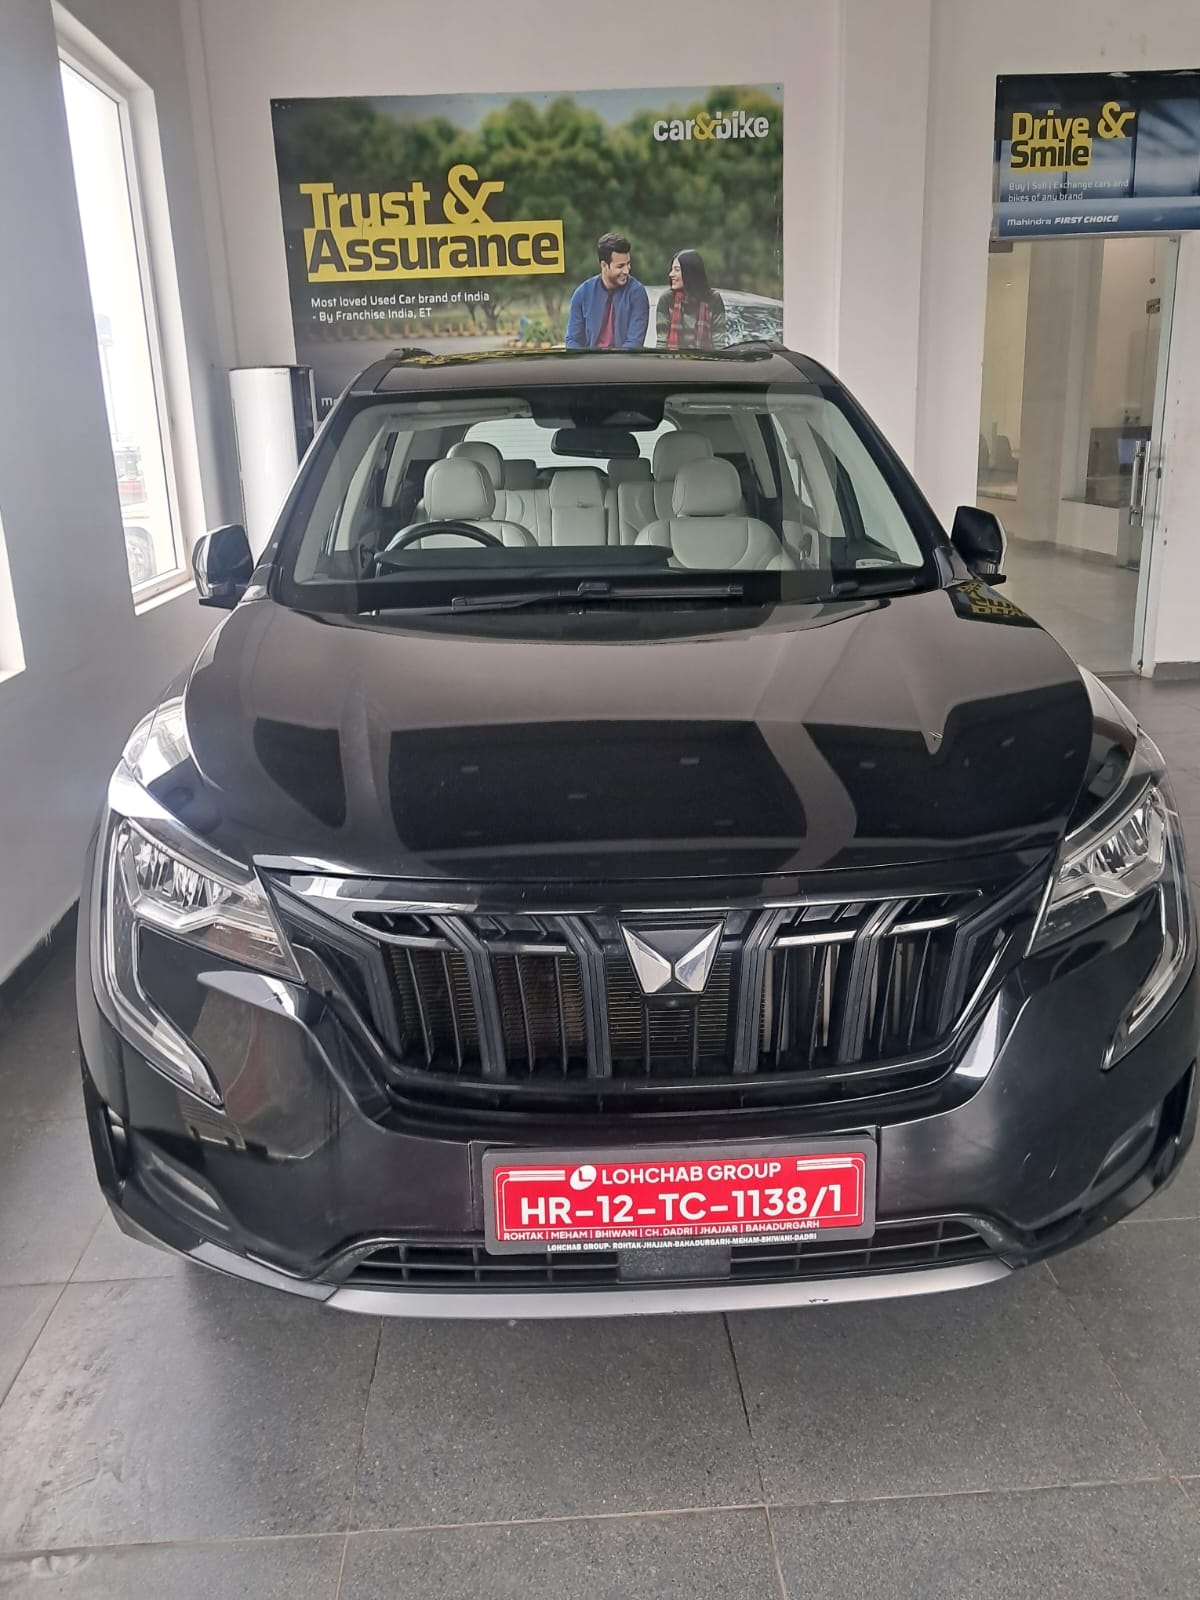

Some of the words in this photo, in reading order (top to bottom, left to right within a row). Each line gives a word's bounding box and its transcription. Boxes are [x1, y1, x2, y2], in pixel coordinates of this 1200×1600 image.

[653, 110, 770, 141] car&bike
[1011, 109, 1090, 140] Drive
[1097, 101, 1136, 139] &
[1010, 138, 1090, 168] Smile
[1008, 182, 1025, 192] Buy
[1053, 180, 1092, 191] Exchange
[1094, 179, 1112, 189] cars
[1114, 178, 1129, 187] and
[300, 182, 430, 230] Trust
[442, 164, 505, 224] &
[1008, 194, 1030, 203] bikes
[1032, 193, 1040, 202] of
[1041, 193, 1058, 204] any
[1060, 192, 1083, 201] brand
[1054, 215, 1083, 225] FIRST
[1083, 214, 1119, 224] CHOICE
[308, 230, 560, 273] Assurance
[311, 296, 337, 308] Most
[339, 295, 367, 307] loved
[370, 294, 396, 305] Used
[399, 293, 416, 304] Car
[418, 292, 448, 303] brand
[450, 291, 462, 303] of
[464, 290, 490, 301] India
[319, 311, 334, 323] By
[336, 309, 385, 321] Franchise
[388, 309, 417, 320] India,
[419, 307, 432, 318] ET
[602, 1166, 702, 1185] LOHCHAB
[707, 1162, 781, 1181] GROUP
[521, 1184, 841, 1225] HR-12-TC-1138/1
[504, 1231, 544, 1241] ROHTAK
[551, 1230, 588, 1240] MEHAM
[595, 1228, 639, 1238] BHIWANI
[645, 1226, 694, 1237] CH.DADRI
[700, 1224, 740, 1235] JHAJJAR
[745, 1220, 820, 1232] BAHADURGARH
[547, 1243, 582, 1252] LOHCHAB
